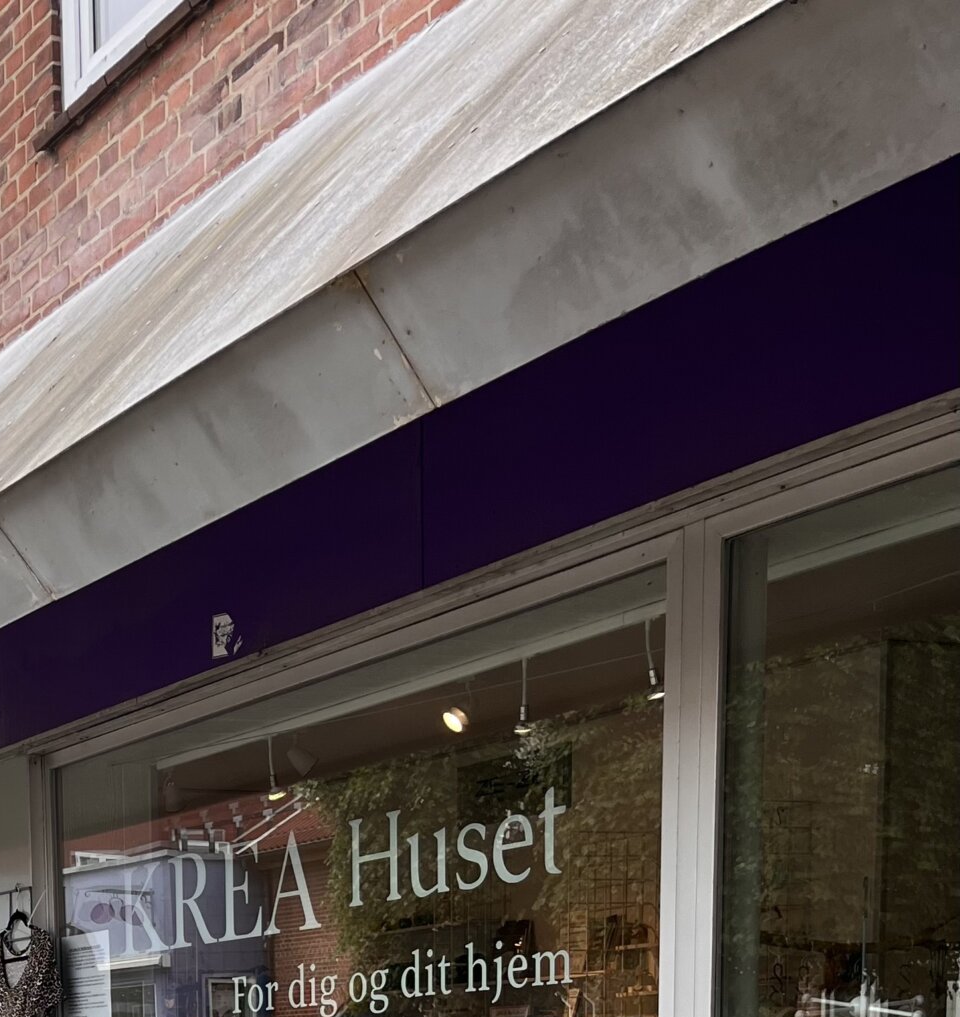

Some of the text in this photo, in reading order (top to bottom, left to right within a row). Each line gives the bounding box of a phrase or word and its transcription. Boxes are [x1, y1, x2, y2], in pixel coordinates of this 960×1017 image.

[120, 786, 567, 957] KREA Huset
[231, 941, 574, 1017] For dig og dit hjem
